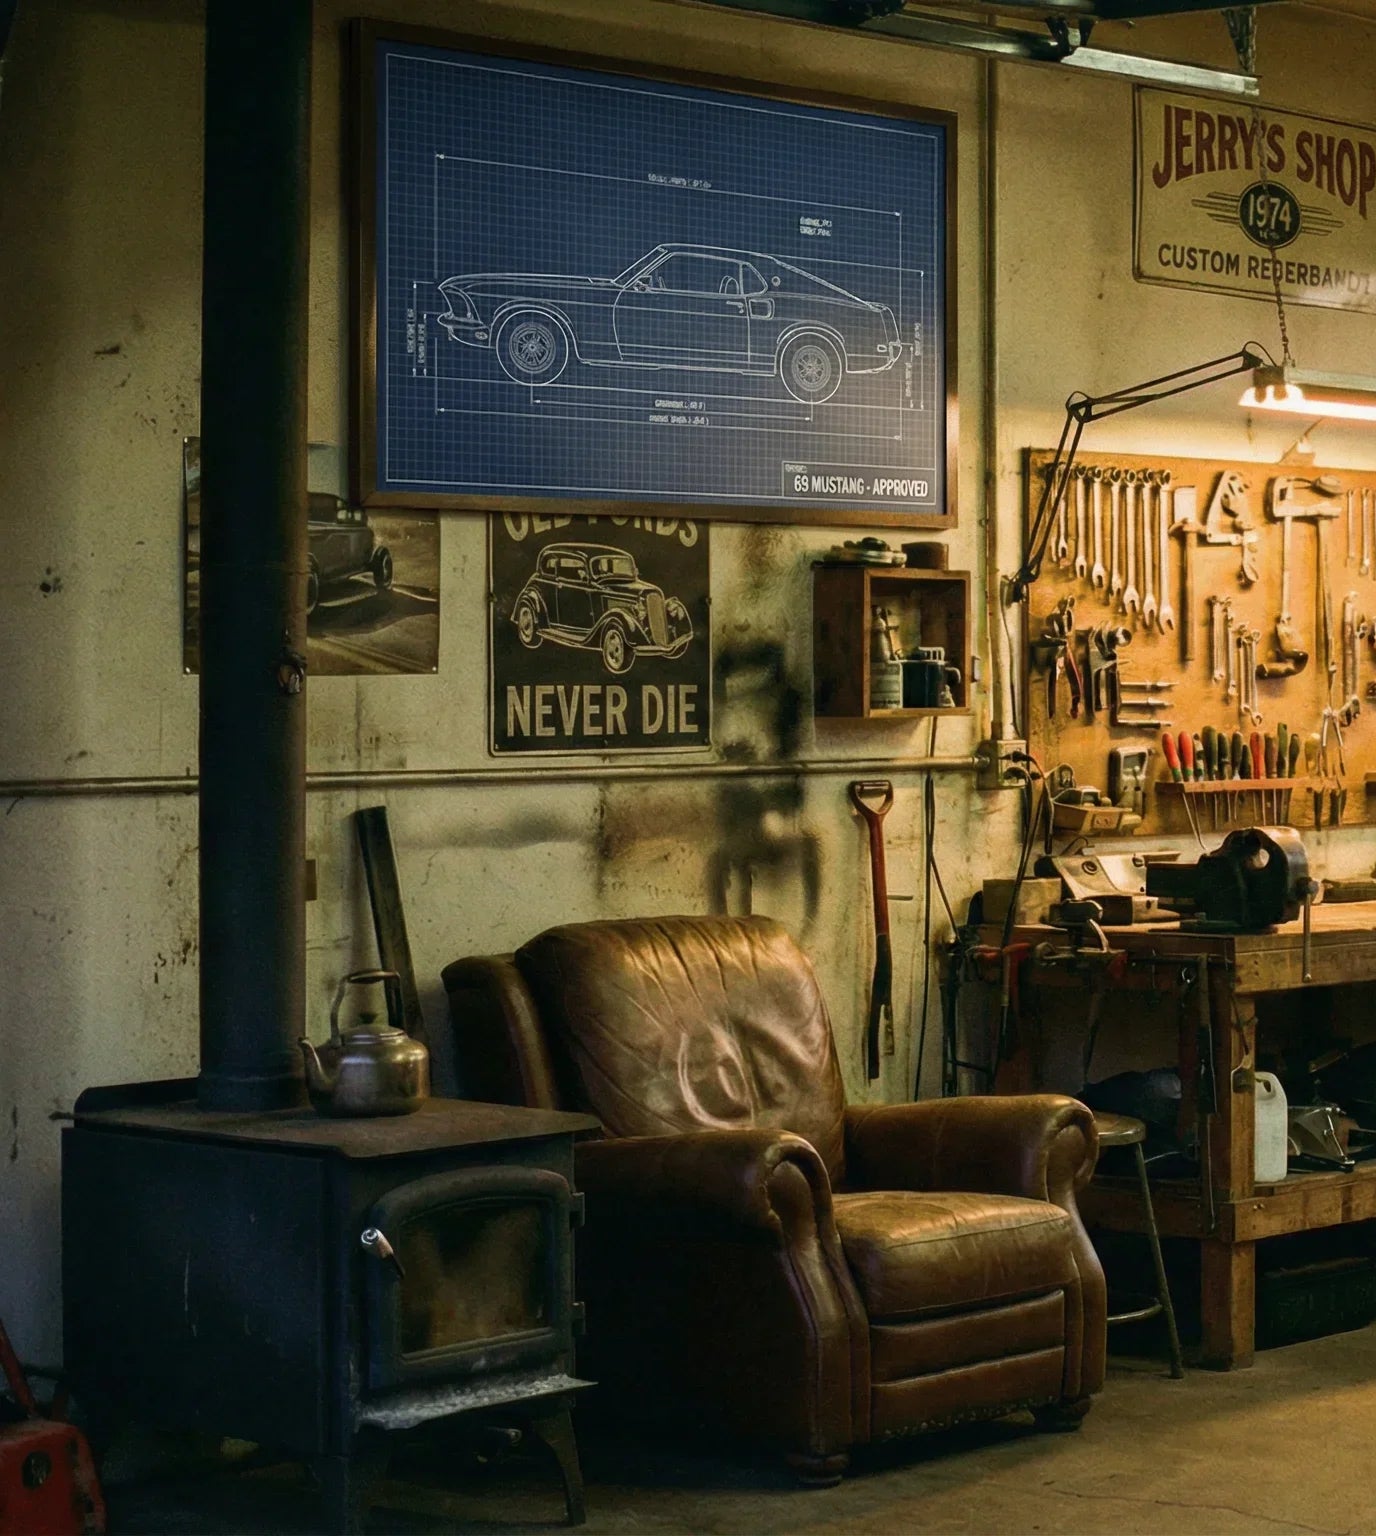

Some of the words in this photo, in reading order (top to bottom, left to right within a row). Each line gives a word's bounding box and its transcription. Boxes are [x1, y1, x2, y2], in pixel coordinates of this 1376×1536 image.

[1152, 104, 1286, 189] JERRY'S
[1296, 130, 1376, 220] SHOP
[1249, 193, 1291, 232] 1974
[1158, 243, 1240, 277] CUSTOM
[794, 475, 808, 491] 69
[811, 475, 864, 494] MUSTANG
[872, 478, 928, 496] APPROVED
[506, 685, 628, 737] NEVER
[642, 684, 699, 735] DIE
